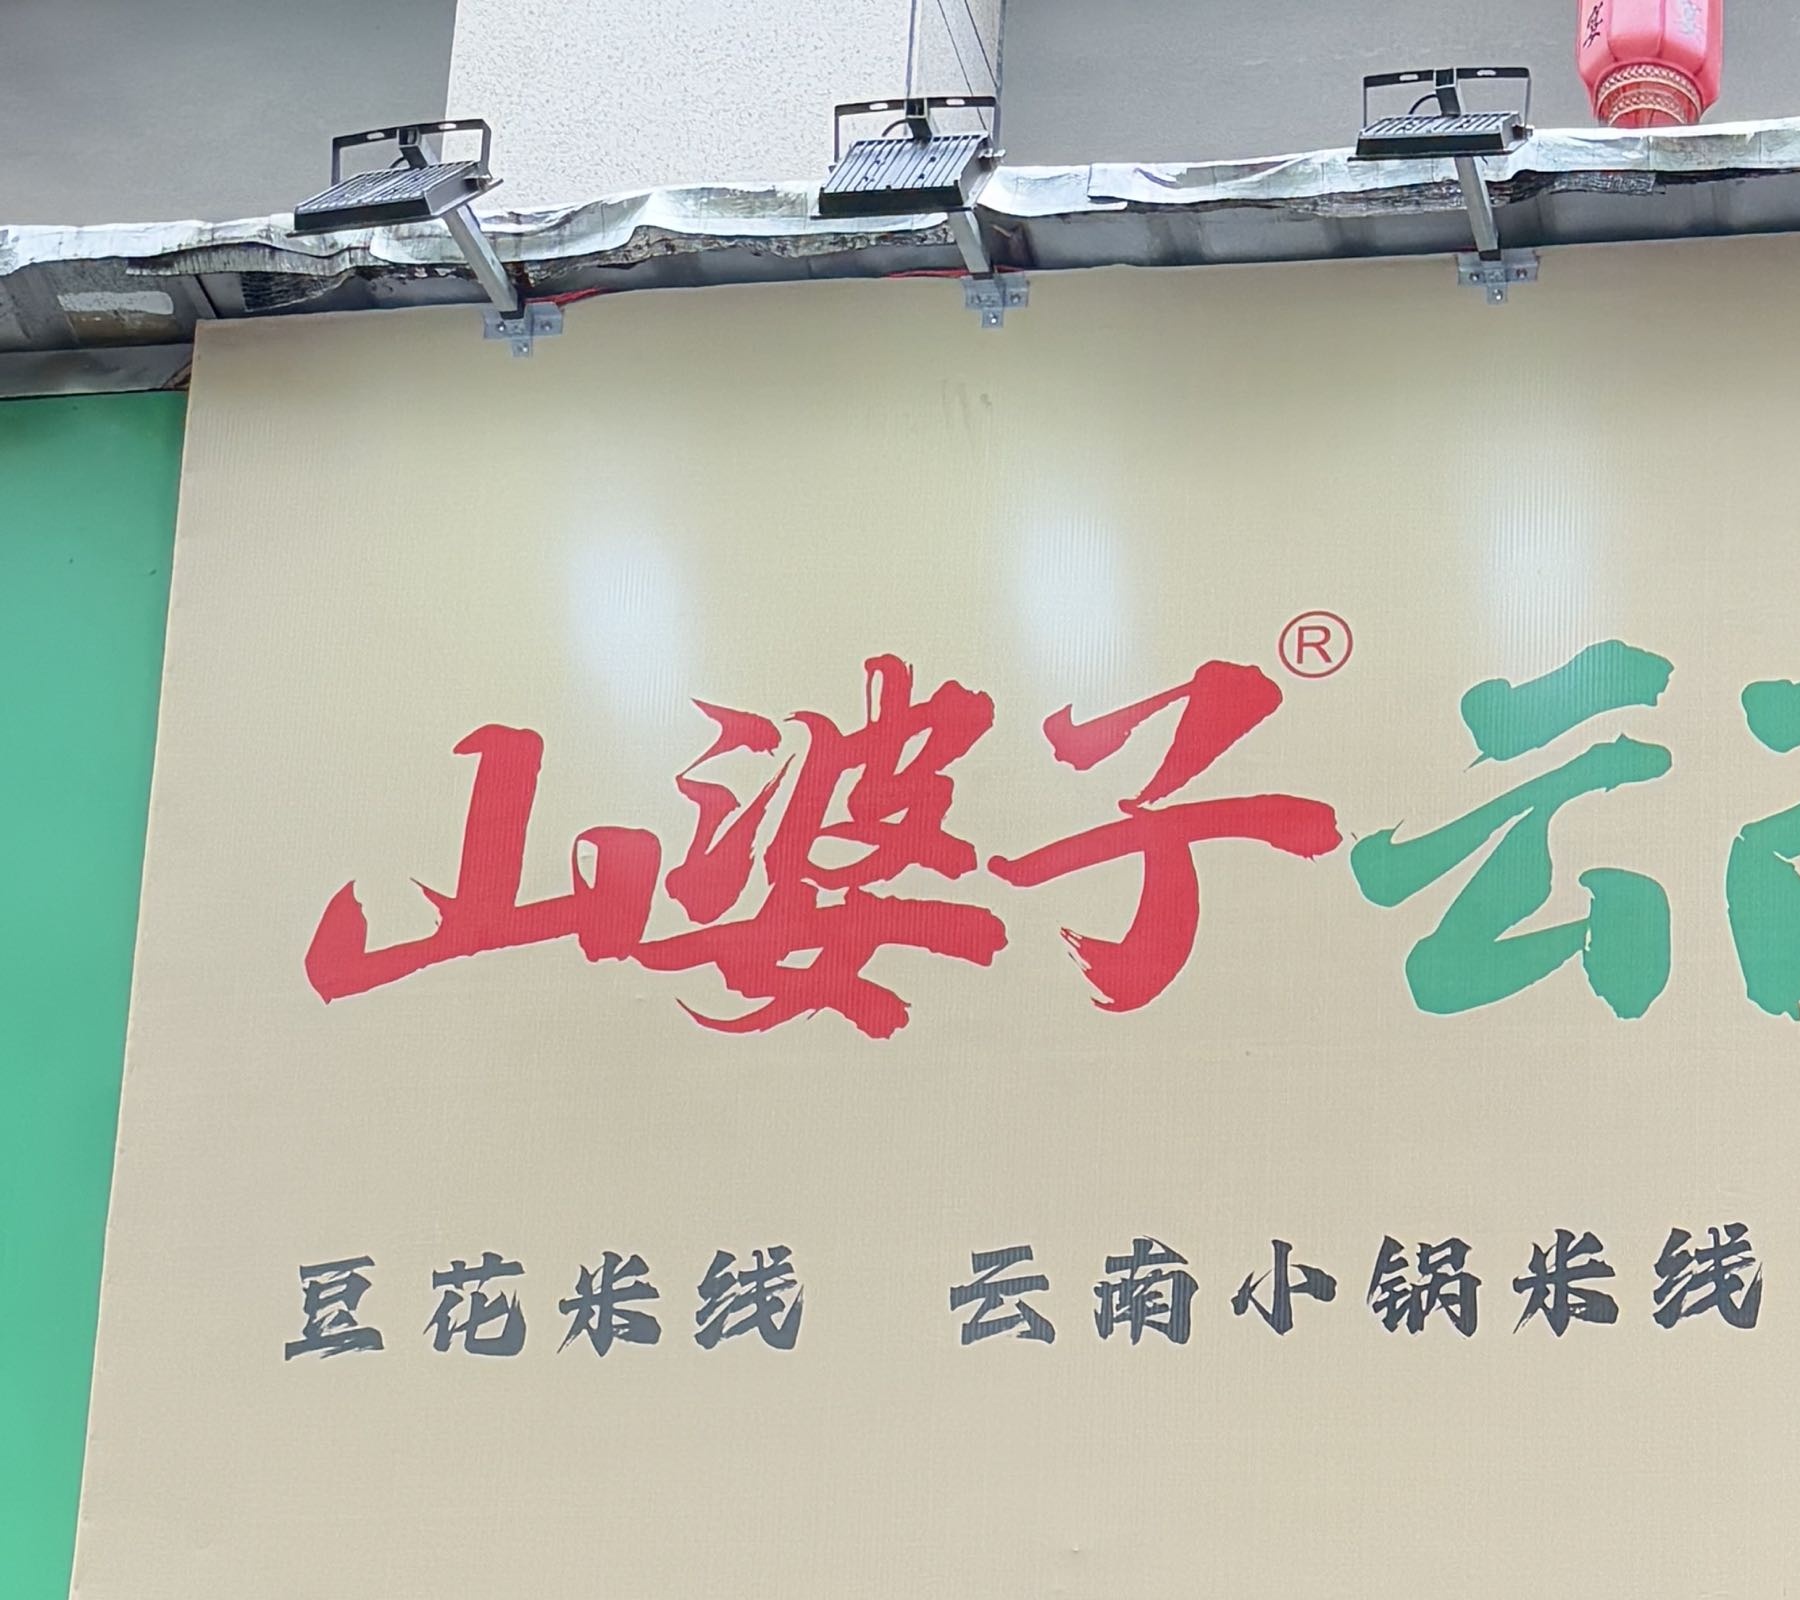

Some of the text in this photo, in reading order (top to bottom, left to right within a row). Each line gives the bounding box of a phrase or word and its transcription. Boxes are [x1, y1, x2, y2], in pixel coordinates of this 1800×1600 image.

[283, 1243, 808, 1361] 豆花米线
[948, 1223, 1767, 1348] 云南小锅米线
